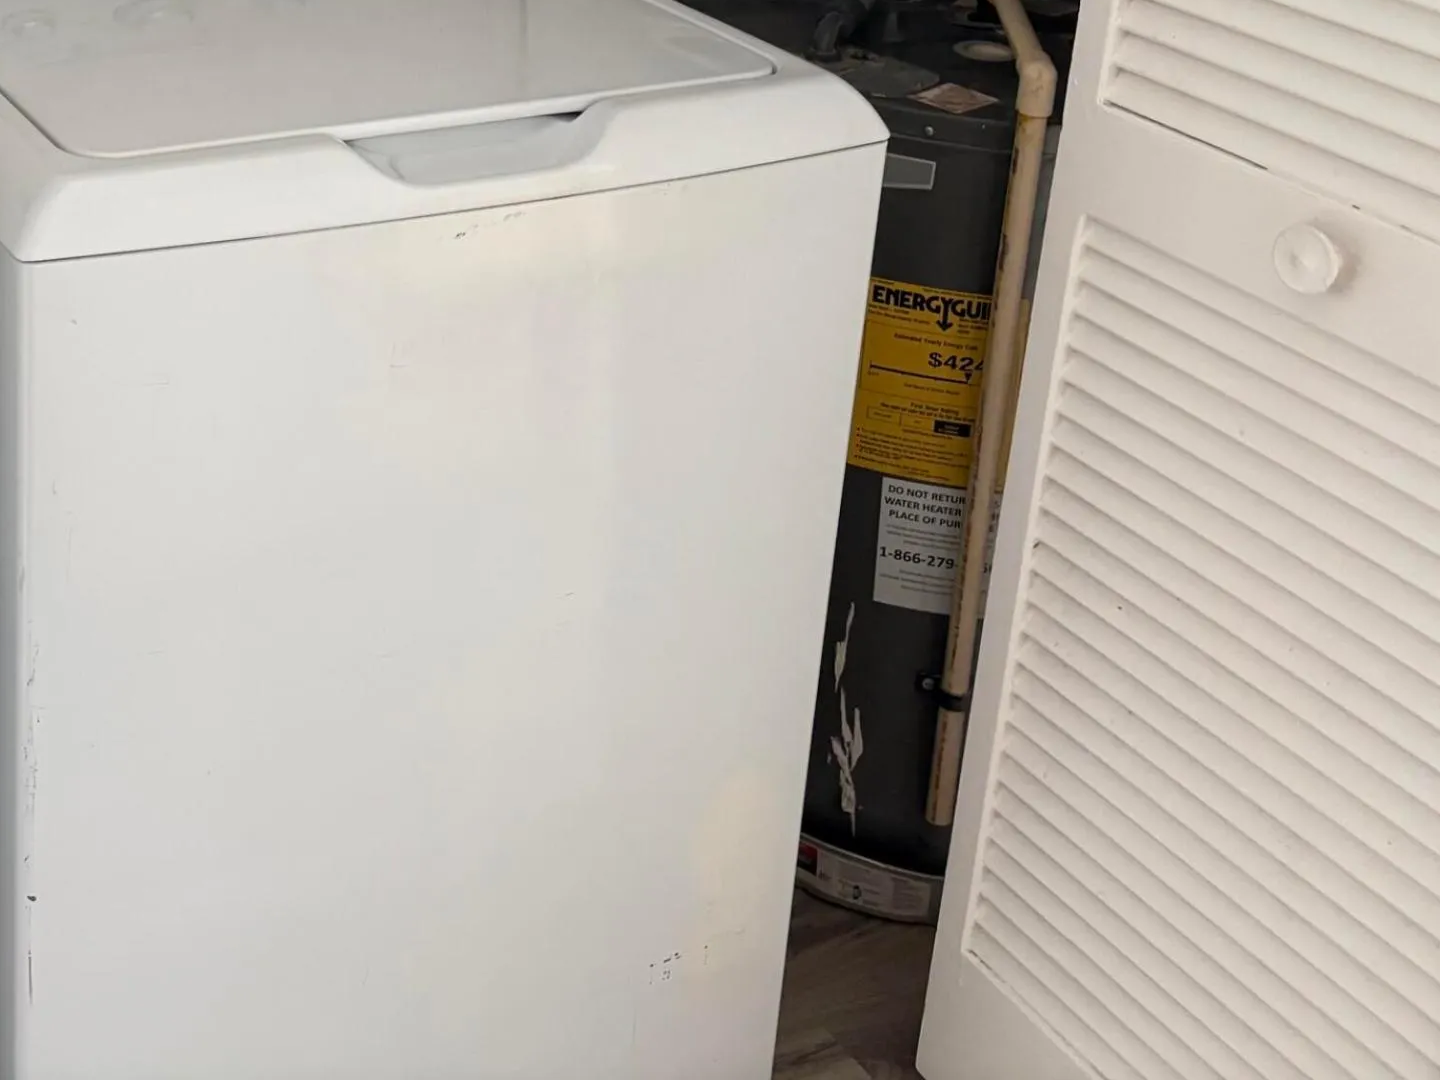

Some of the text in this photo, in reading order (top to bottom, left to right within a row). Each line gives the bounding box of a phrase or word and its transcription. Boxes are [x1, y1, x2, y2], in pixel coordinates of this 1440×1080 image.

[872, 283, 992, 324] ENERGYGUI
[887, 484, 967, 505] DO NOT RETUR
[884, 495, 962, 517] WATER HEATER
[888, 509, 920, 523] PLACE
[922, 515, 937, 525] OF
